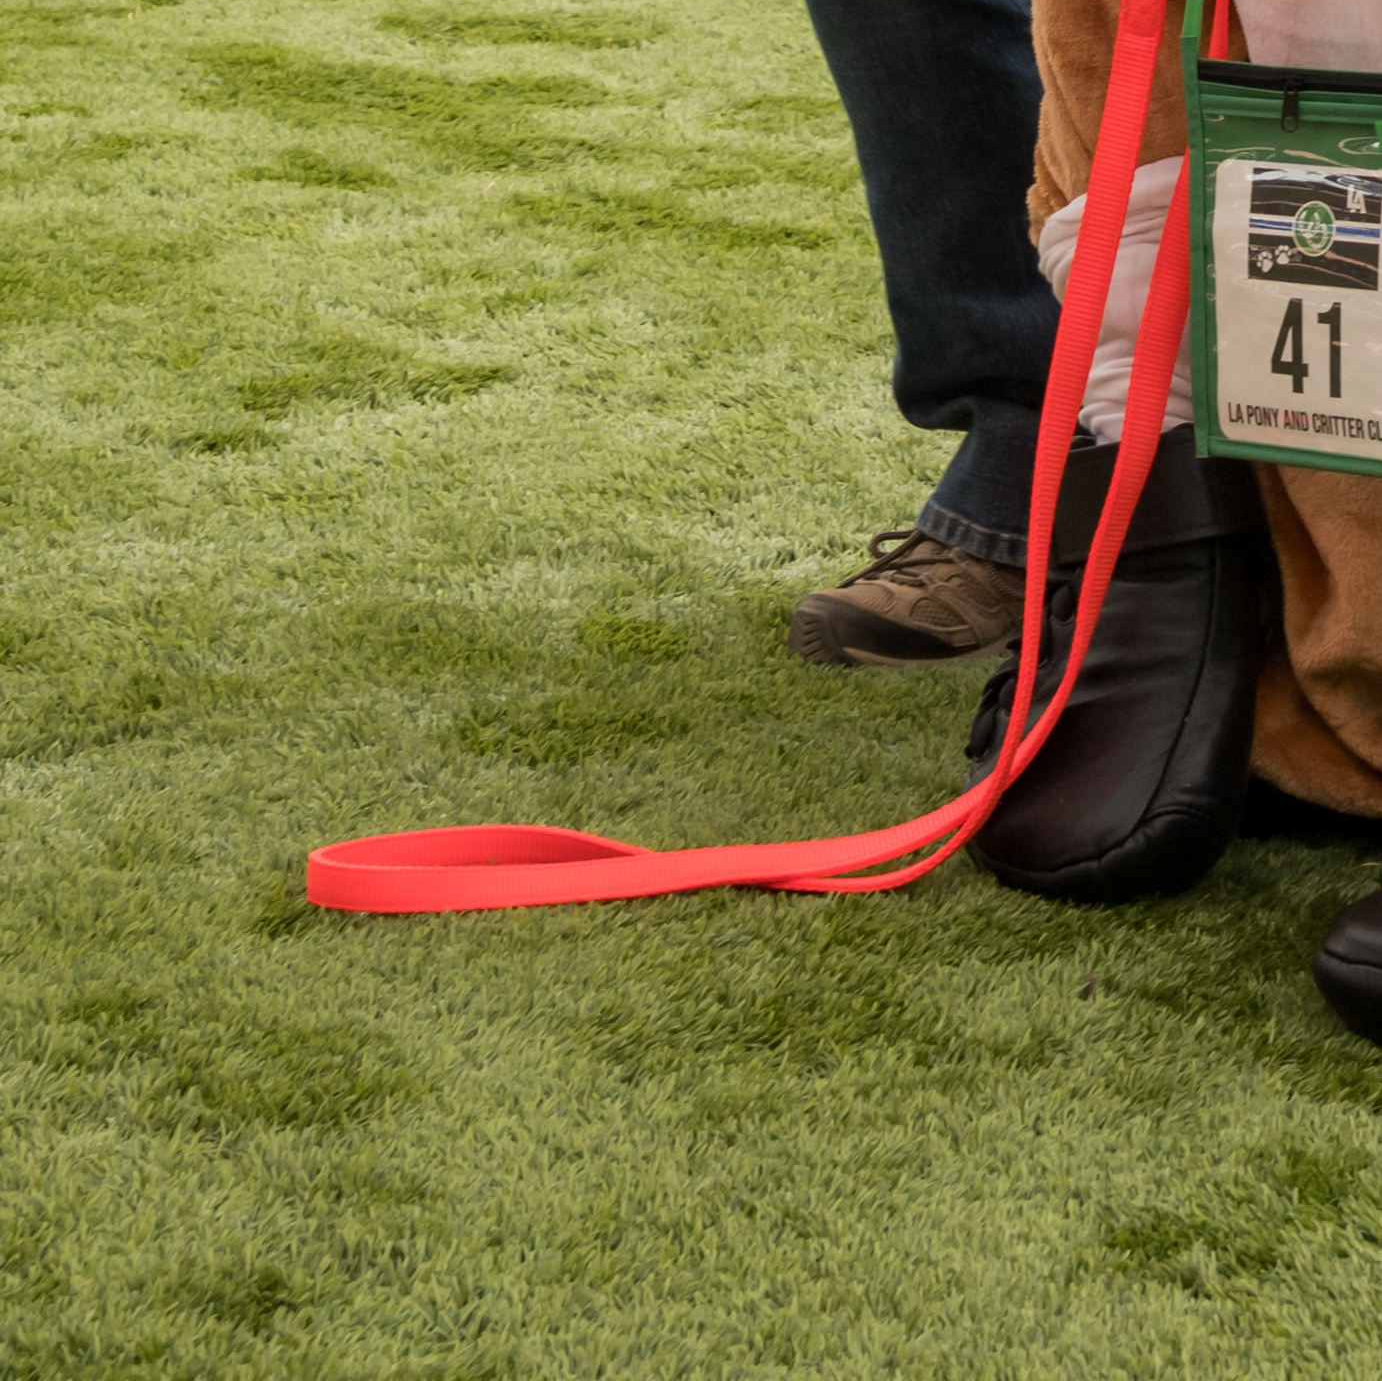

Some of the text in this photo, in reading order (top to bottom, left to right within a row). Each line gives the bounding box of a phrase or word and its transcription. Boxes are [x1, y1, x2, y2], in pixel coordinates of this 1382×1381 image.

[1270, 297, 1343, 399] 41
[1228, 402, 1245, 424] LA
[1246, 405, 1279, 428] PONY
[1283, 409, 1309, 432] AND
[1312, 413, 1365, 440] CRITTER
